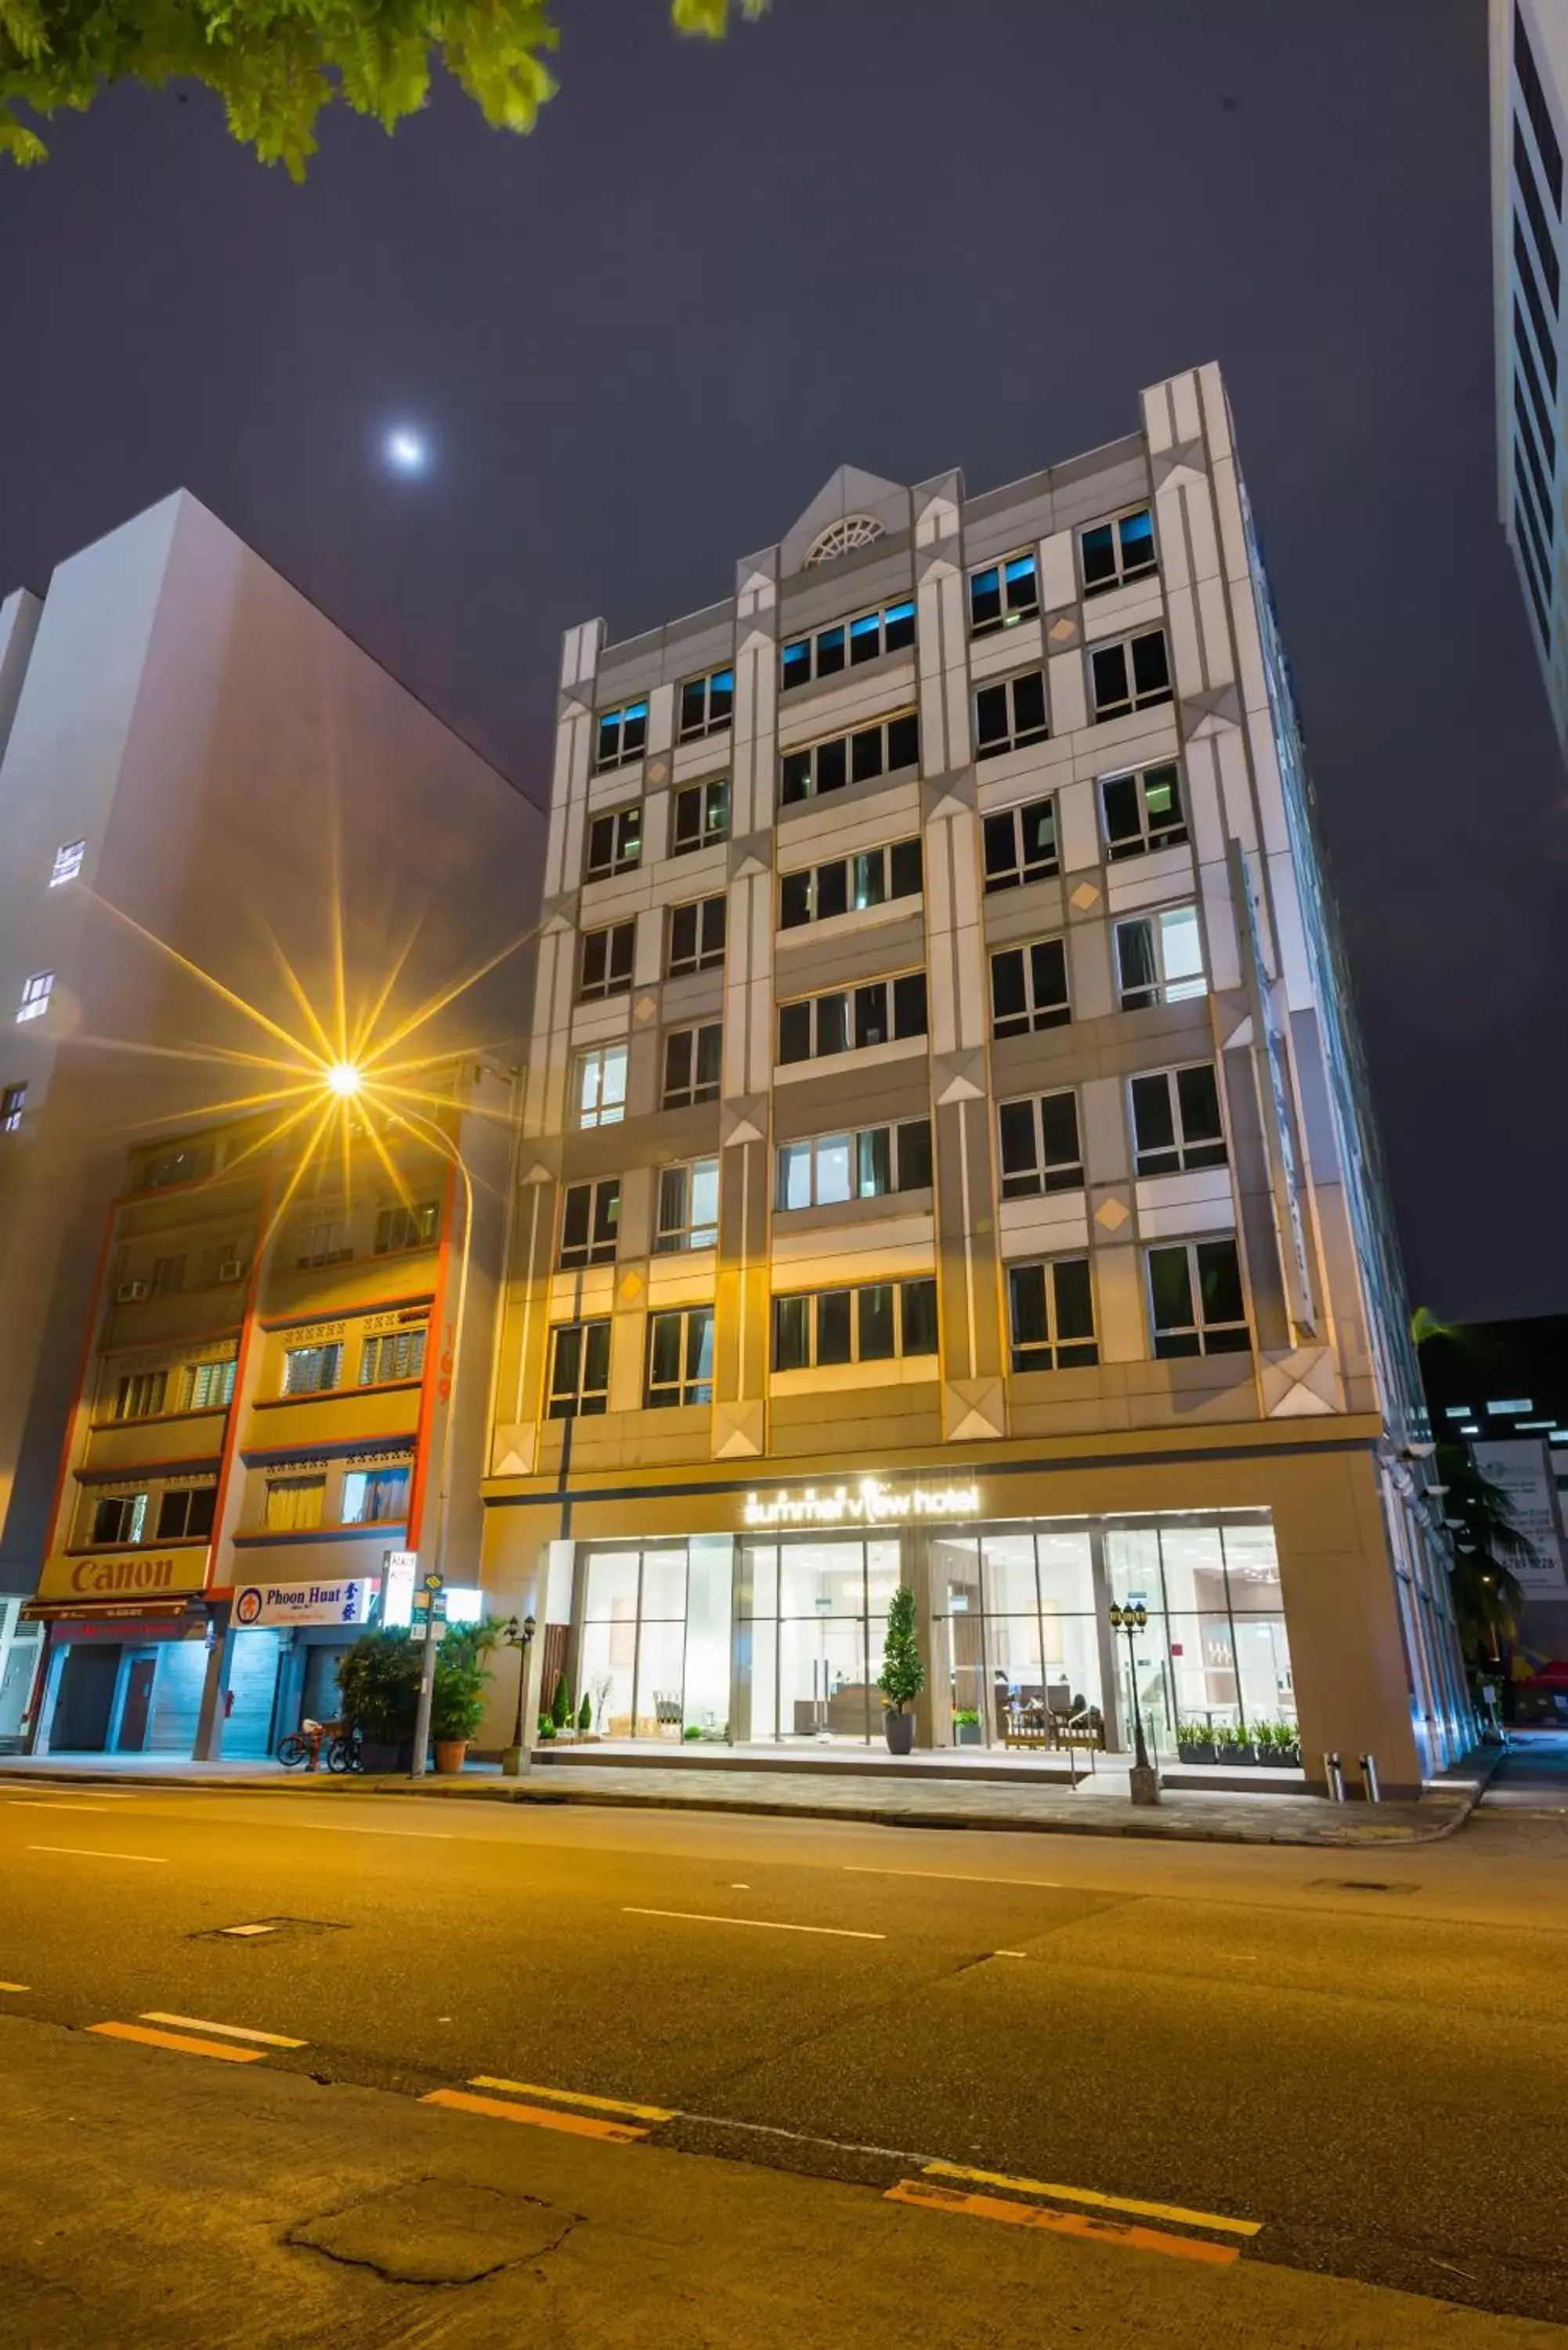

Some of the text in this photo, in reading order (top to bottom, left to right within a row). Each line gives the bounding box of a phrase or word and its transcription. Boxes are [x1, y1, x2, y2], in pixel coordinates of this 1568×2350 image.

[913, 1486, 979, 1514] hotel
[71, 1560, 173, 1593] Canon
[266, 1586, 341, 1605] Phoon Huat
